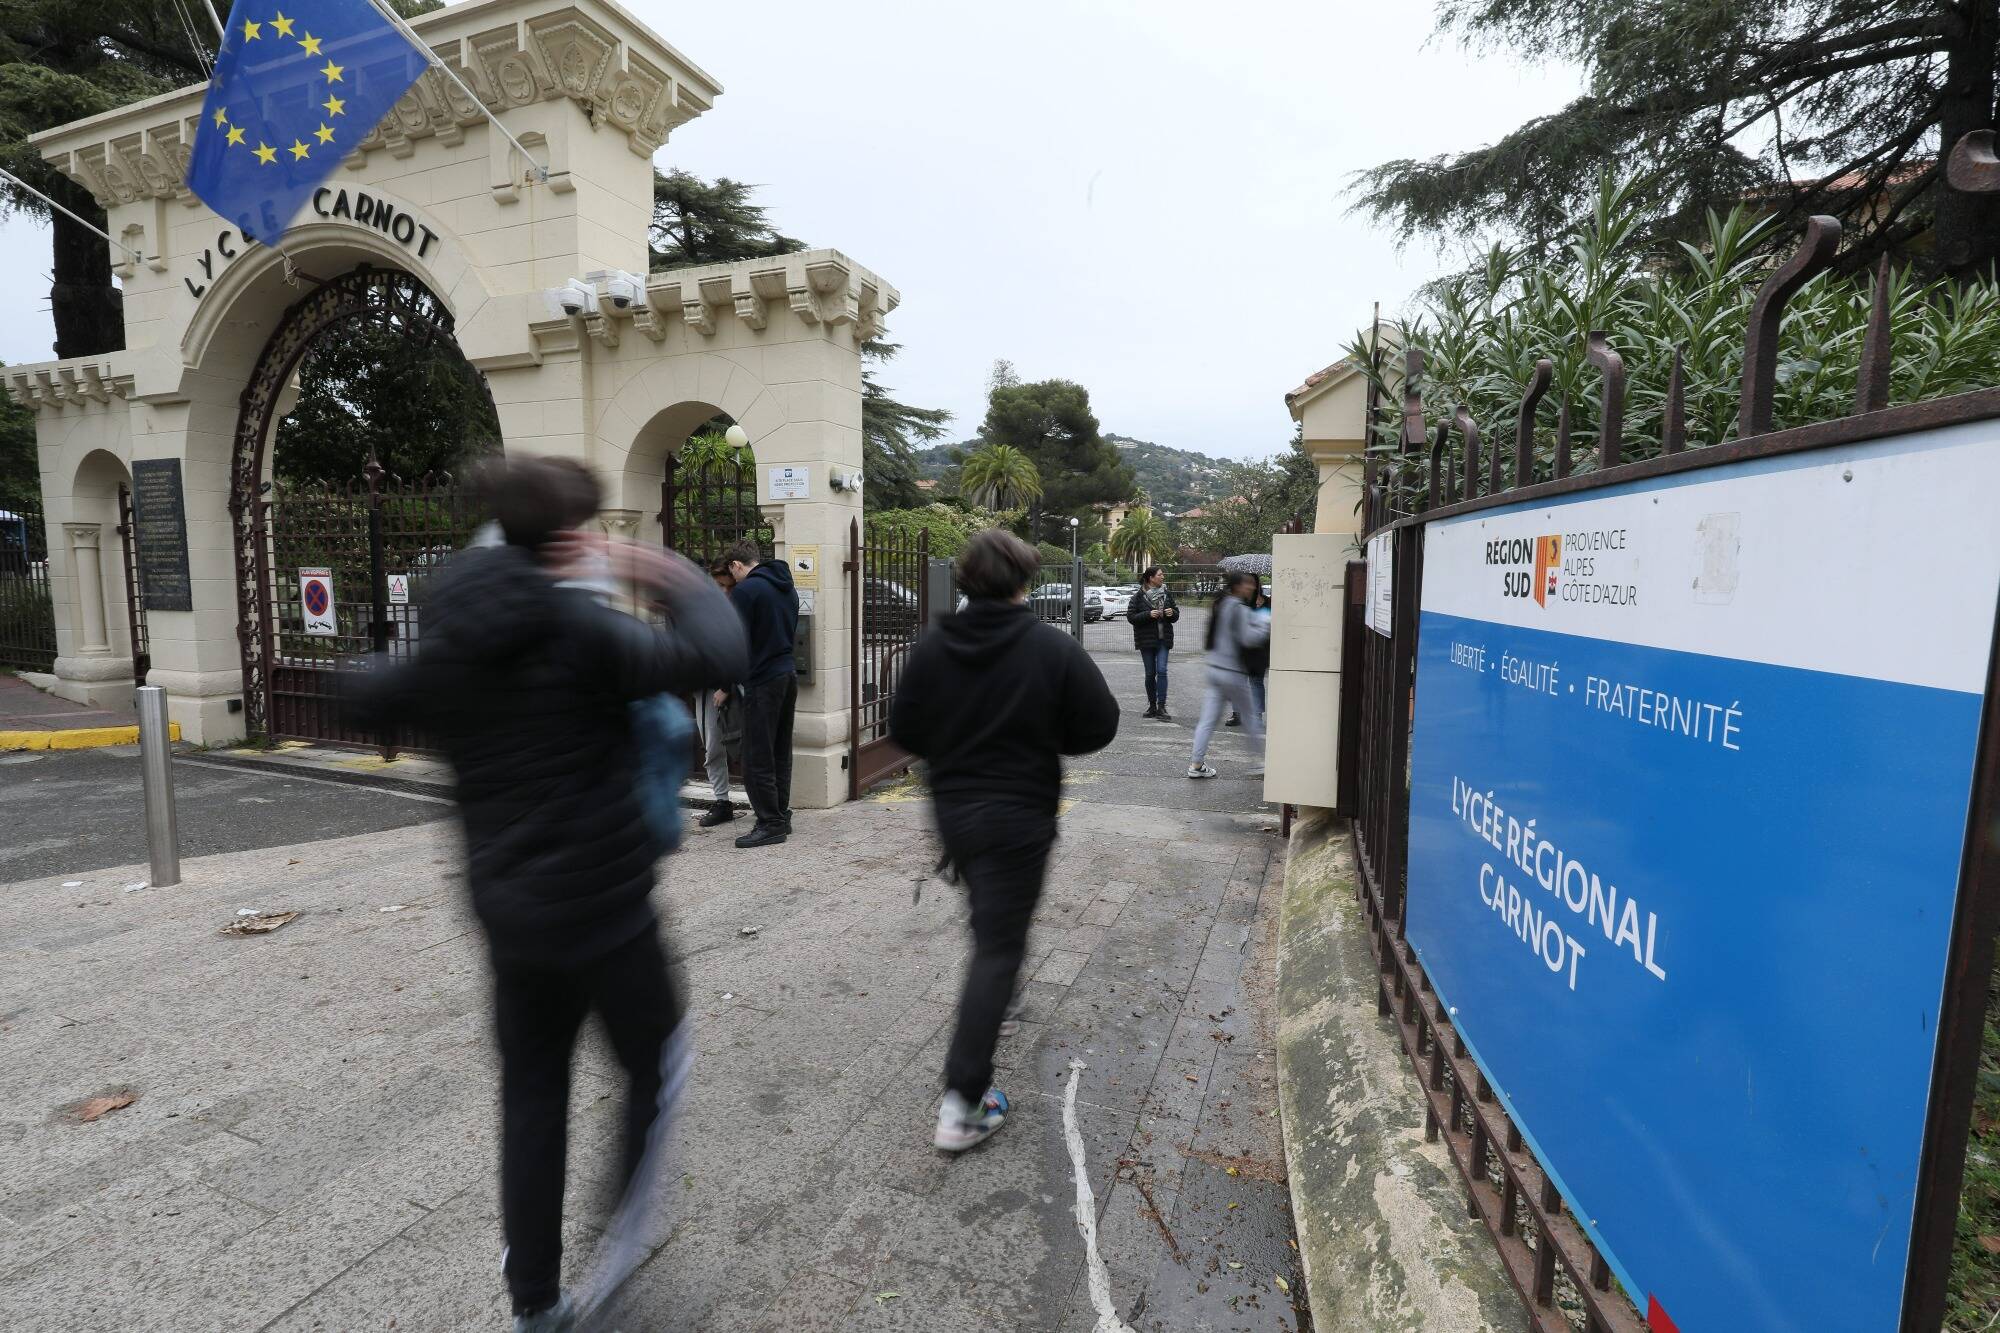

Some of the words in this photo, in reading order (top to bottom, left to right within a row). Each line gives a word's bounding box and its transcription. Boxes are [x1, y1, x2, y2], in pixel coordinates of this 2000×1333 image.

[312, 187, 439, 258] CARNOT
[1485, 535, 1534, 565] RÉGION
[1564, 529, 1627, 552] PROVENCE
[1563, 557, 1595, 577] ALPES
[1503, 572, 1531, 598] SUD
[1562, 579, 1592, 602] CÔTE
[1592, 584, 1638, 606] D'AZUR
[1449, 641, 1486, 673] LIBERTÉ
[1500, 650, 1560, 697] ÉGALITÉ
[1585, 675, 1743, 751] FRATERNITÉ
[1452, 775, 1504, 852] LYCÉE
[1506, 816, 1666, 982] RÉGIONAL
[1479, 862, 1586, 992] CARNOT
